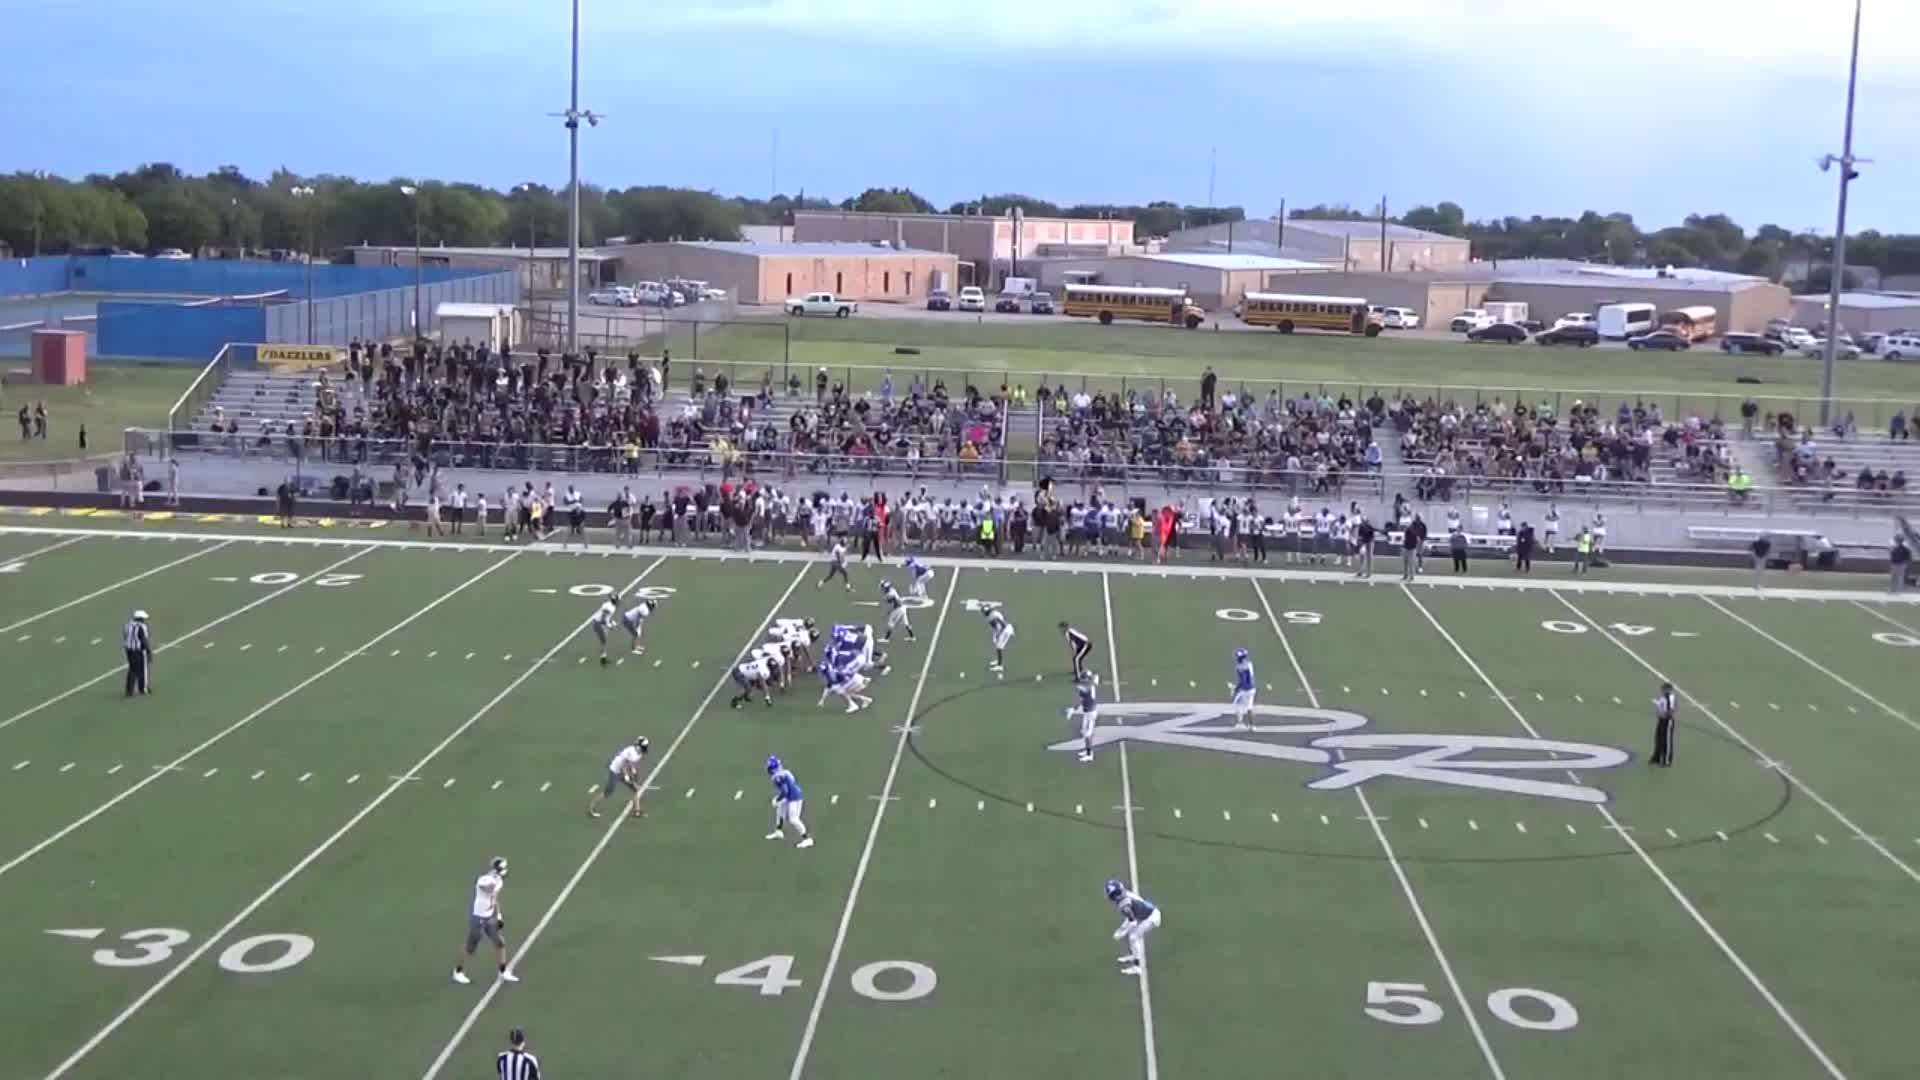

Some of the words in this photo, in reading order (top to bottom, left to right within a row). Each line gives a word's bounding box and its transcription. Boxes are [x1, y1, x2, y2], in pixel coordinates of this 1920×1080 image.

[93, 928, 315, 973] 30
[714, 955, 938, 1001] 40
[1363, 981, 1579, 1031] 50
